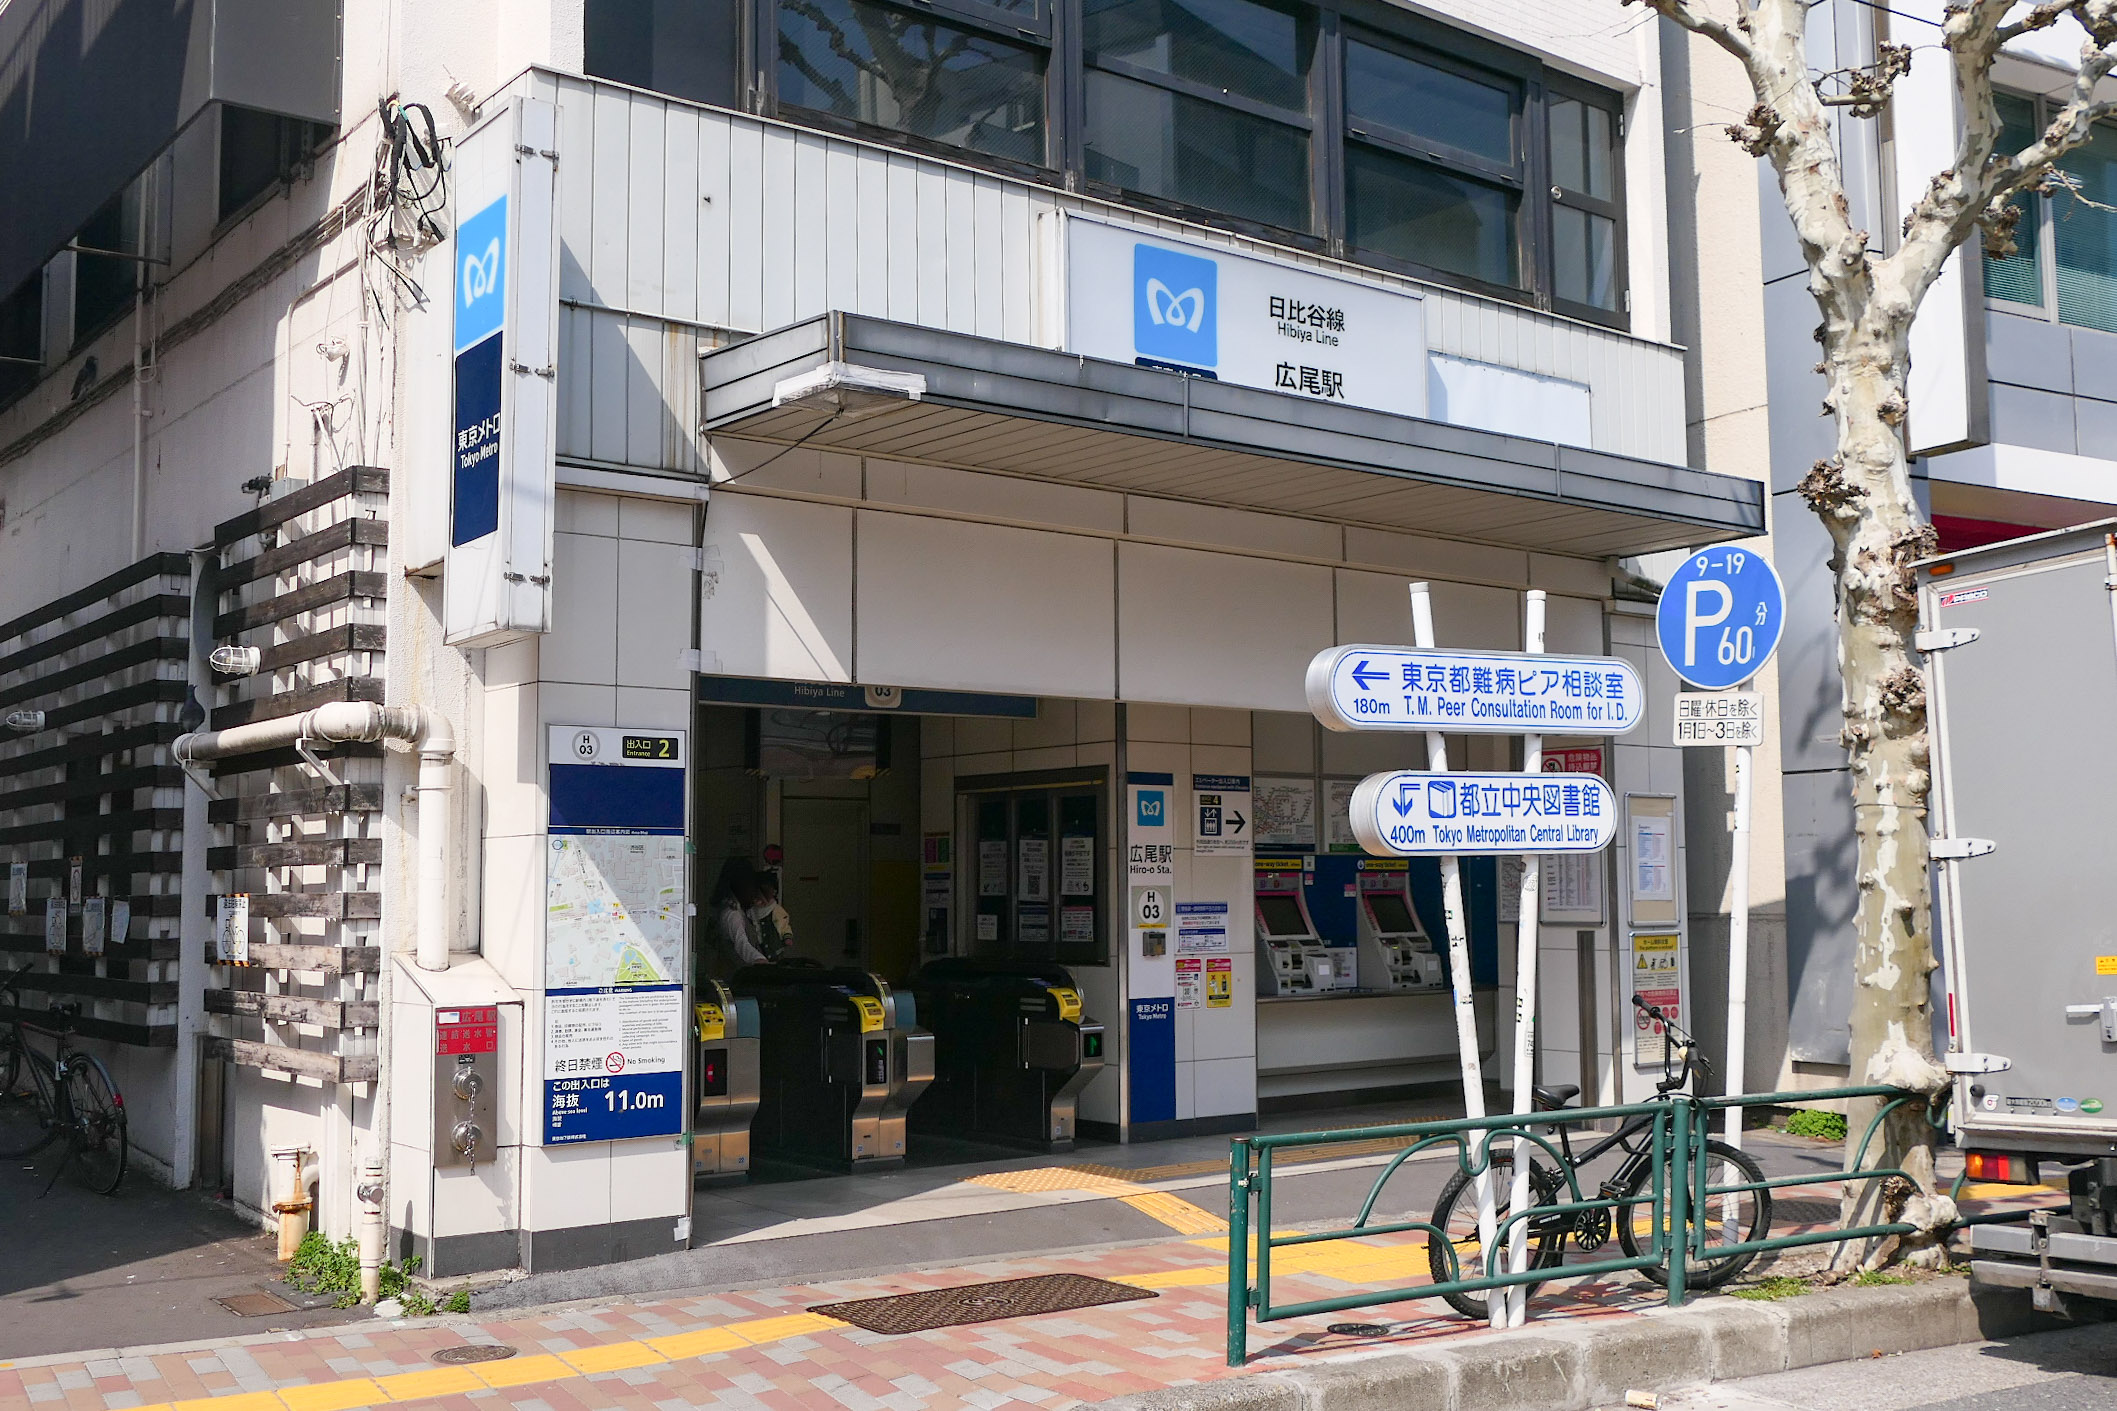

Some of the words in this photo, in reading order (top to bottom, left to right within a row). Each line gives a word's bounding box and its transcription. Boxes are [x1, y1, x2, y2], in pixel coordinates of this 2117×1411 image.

[1269, 296, 1345, 331] 日比谷線
[1277, 322, 1312, 342] Hibiya
[1315, 329, 1339, 347] Line
[1275, 362, 1344, 399] 広尾駅
[457, 412, 501, 452] 東京メトロ
[461, 451, 480, 468] Tokyo
[480, 442, 498, 460] Metro
[1696, 553, 1745, 577] 9-19
[1684, 579, 1733, 666] P
[1718, 626, 1753, 665] 60
[1755, 602, 1768, 625] 分
[1401, 662, 1624, 699] 東京都難病ピア相談室
[794, 686, 823, 698] Hibiya
[826, 688, 845, 697] Line
[1353, 698, 1390, 715] 180m
[1437, 698, 1466, 717] Peer
[1471, 698, 1546, 719] Consultation
[1550, 701, 1582, 720] Room
[1587, 701, 1601, 720] for
[583, 735, 590, 743] H
[626, 739, 651, 749] 出入口
[658, 739, 670, 758] 2
[579, 745, 593, 755] 03
[1460, 783, 1600, 818] 都立中央図書館
[1390, 825, 1425, 844] 400m
[1433, 824, 1462, 847] Tokyo
[1467, 825, 1526, 846] Metropolitan
[1530, 824, 1564, 843] Central
[1567, 825, 1598, 845] Library
[1130, 844, 1172, 863] 広尾駅
[1130, 865, 1155, 874] Hiro-o
[1157, 865, 1172, 874] Sta.
[1147, 892, 1155, 902] H
[1143, 905, 1160, 919] 03
[1136, 1003, 1169, 1013] 東京メトロ
[554, 1057, 603, 1073] 終日禁煙
[638, 1056, 666, 1065] Smoking
[553, 1078, 610, 1091] この出入口は
[552, 1093, 580, 1108] 海抜
[604, 1090, 664, 1112] 11.0m
